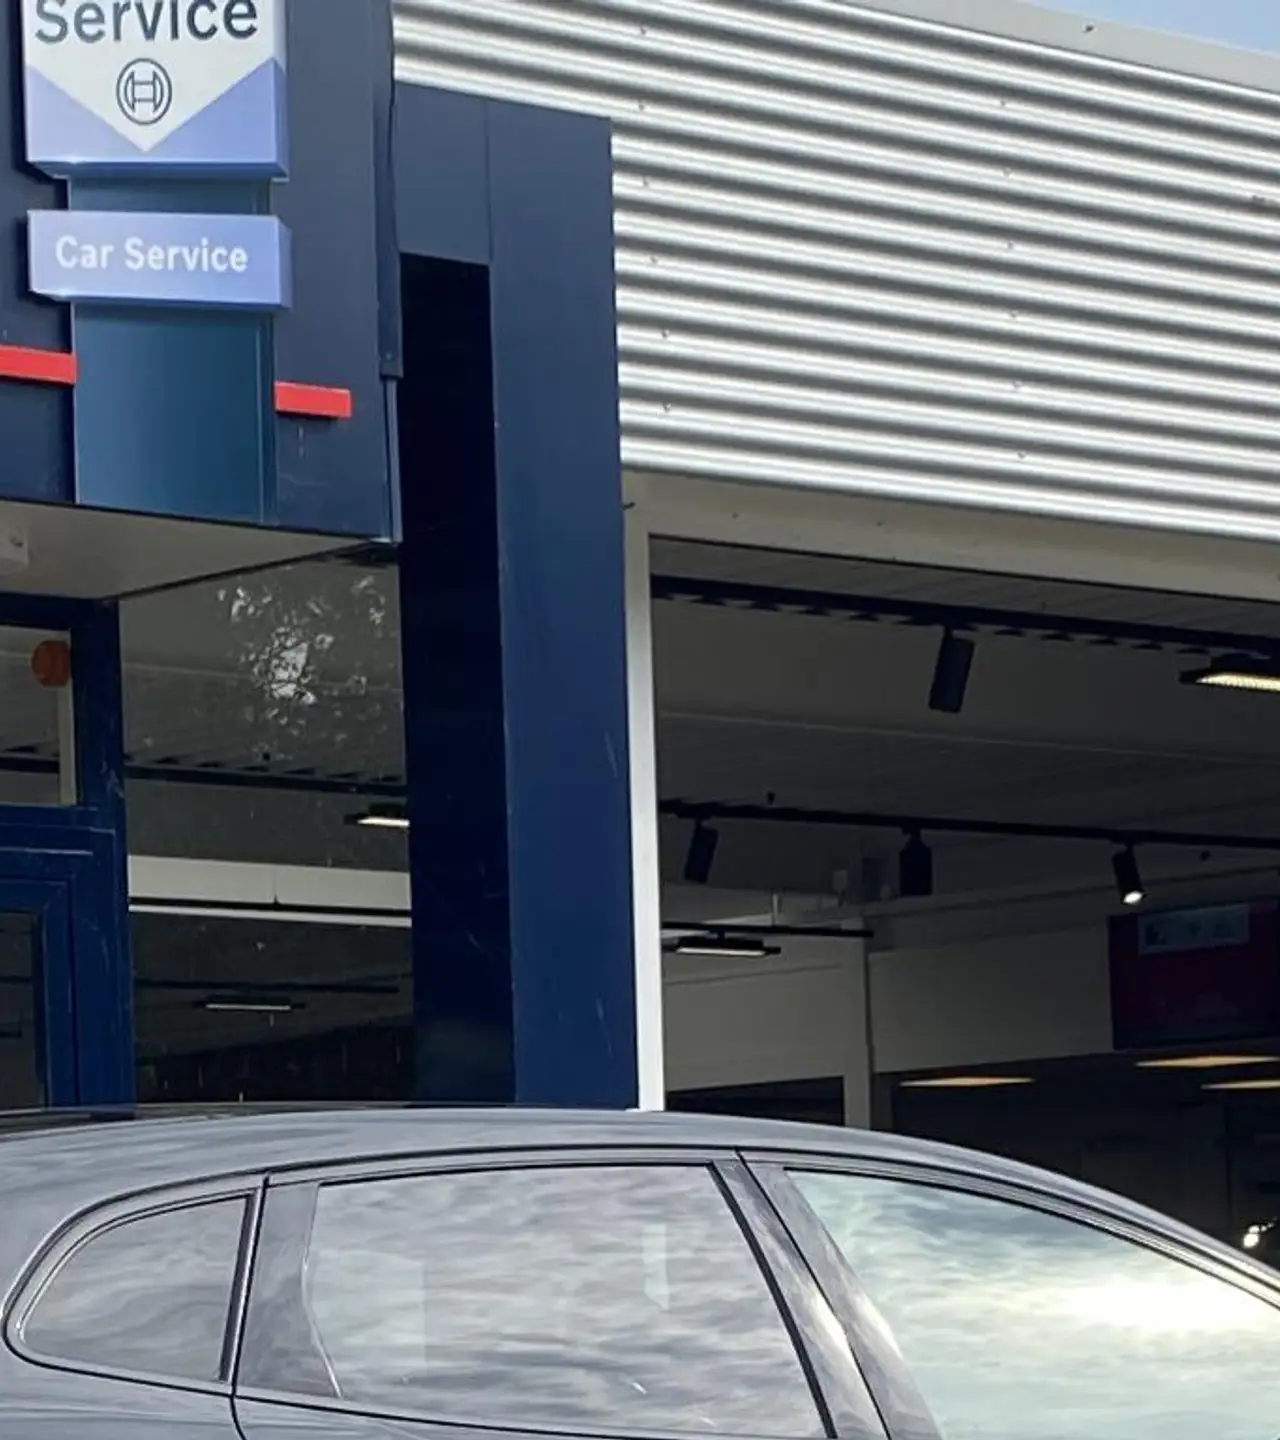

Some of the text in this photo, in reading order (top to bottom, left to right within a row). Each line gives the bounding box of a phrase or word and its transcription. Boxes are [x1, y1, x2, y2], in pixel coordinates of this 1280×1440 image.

[34, 0, 258, 43] Service
[55, 236, 249, 271] Car Service
